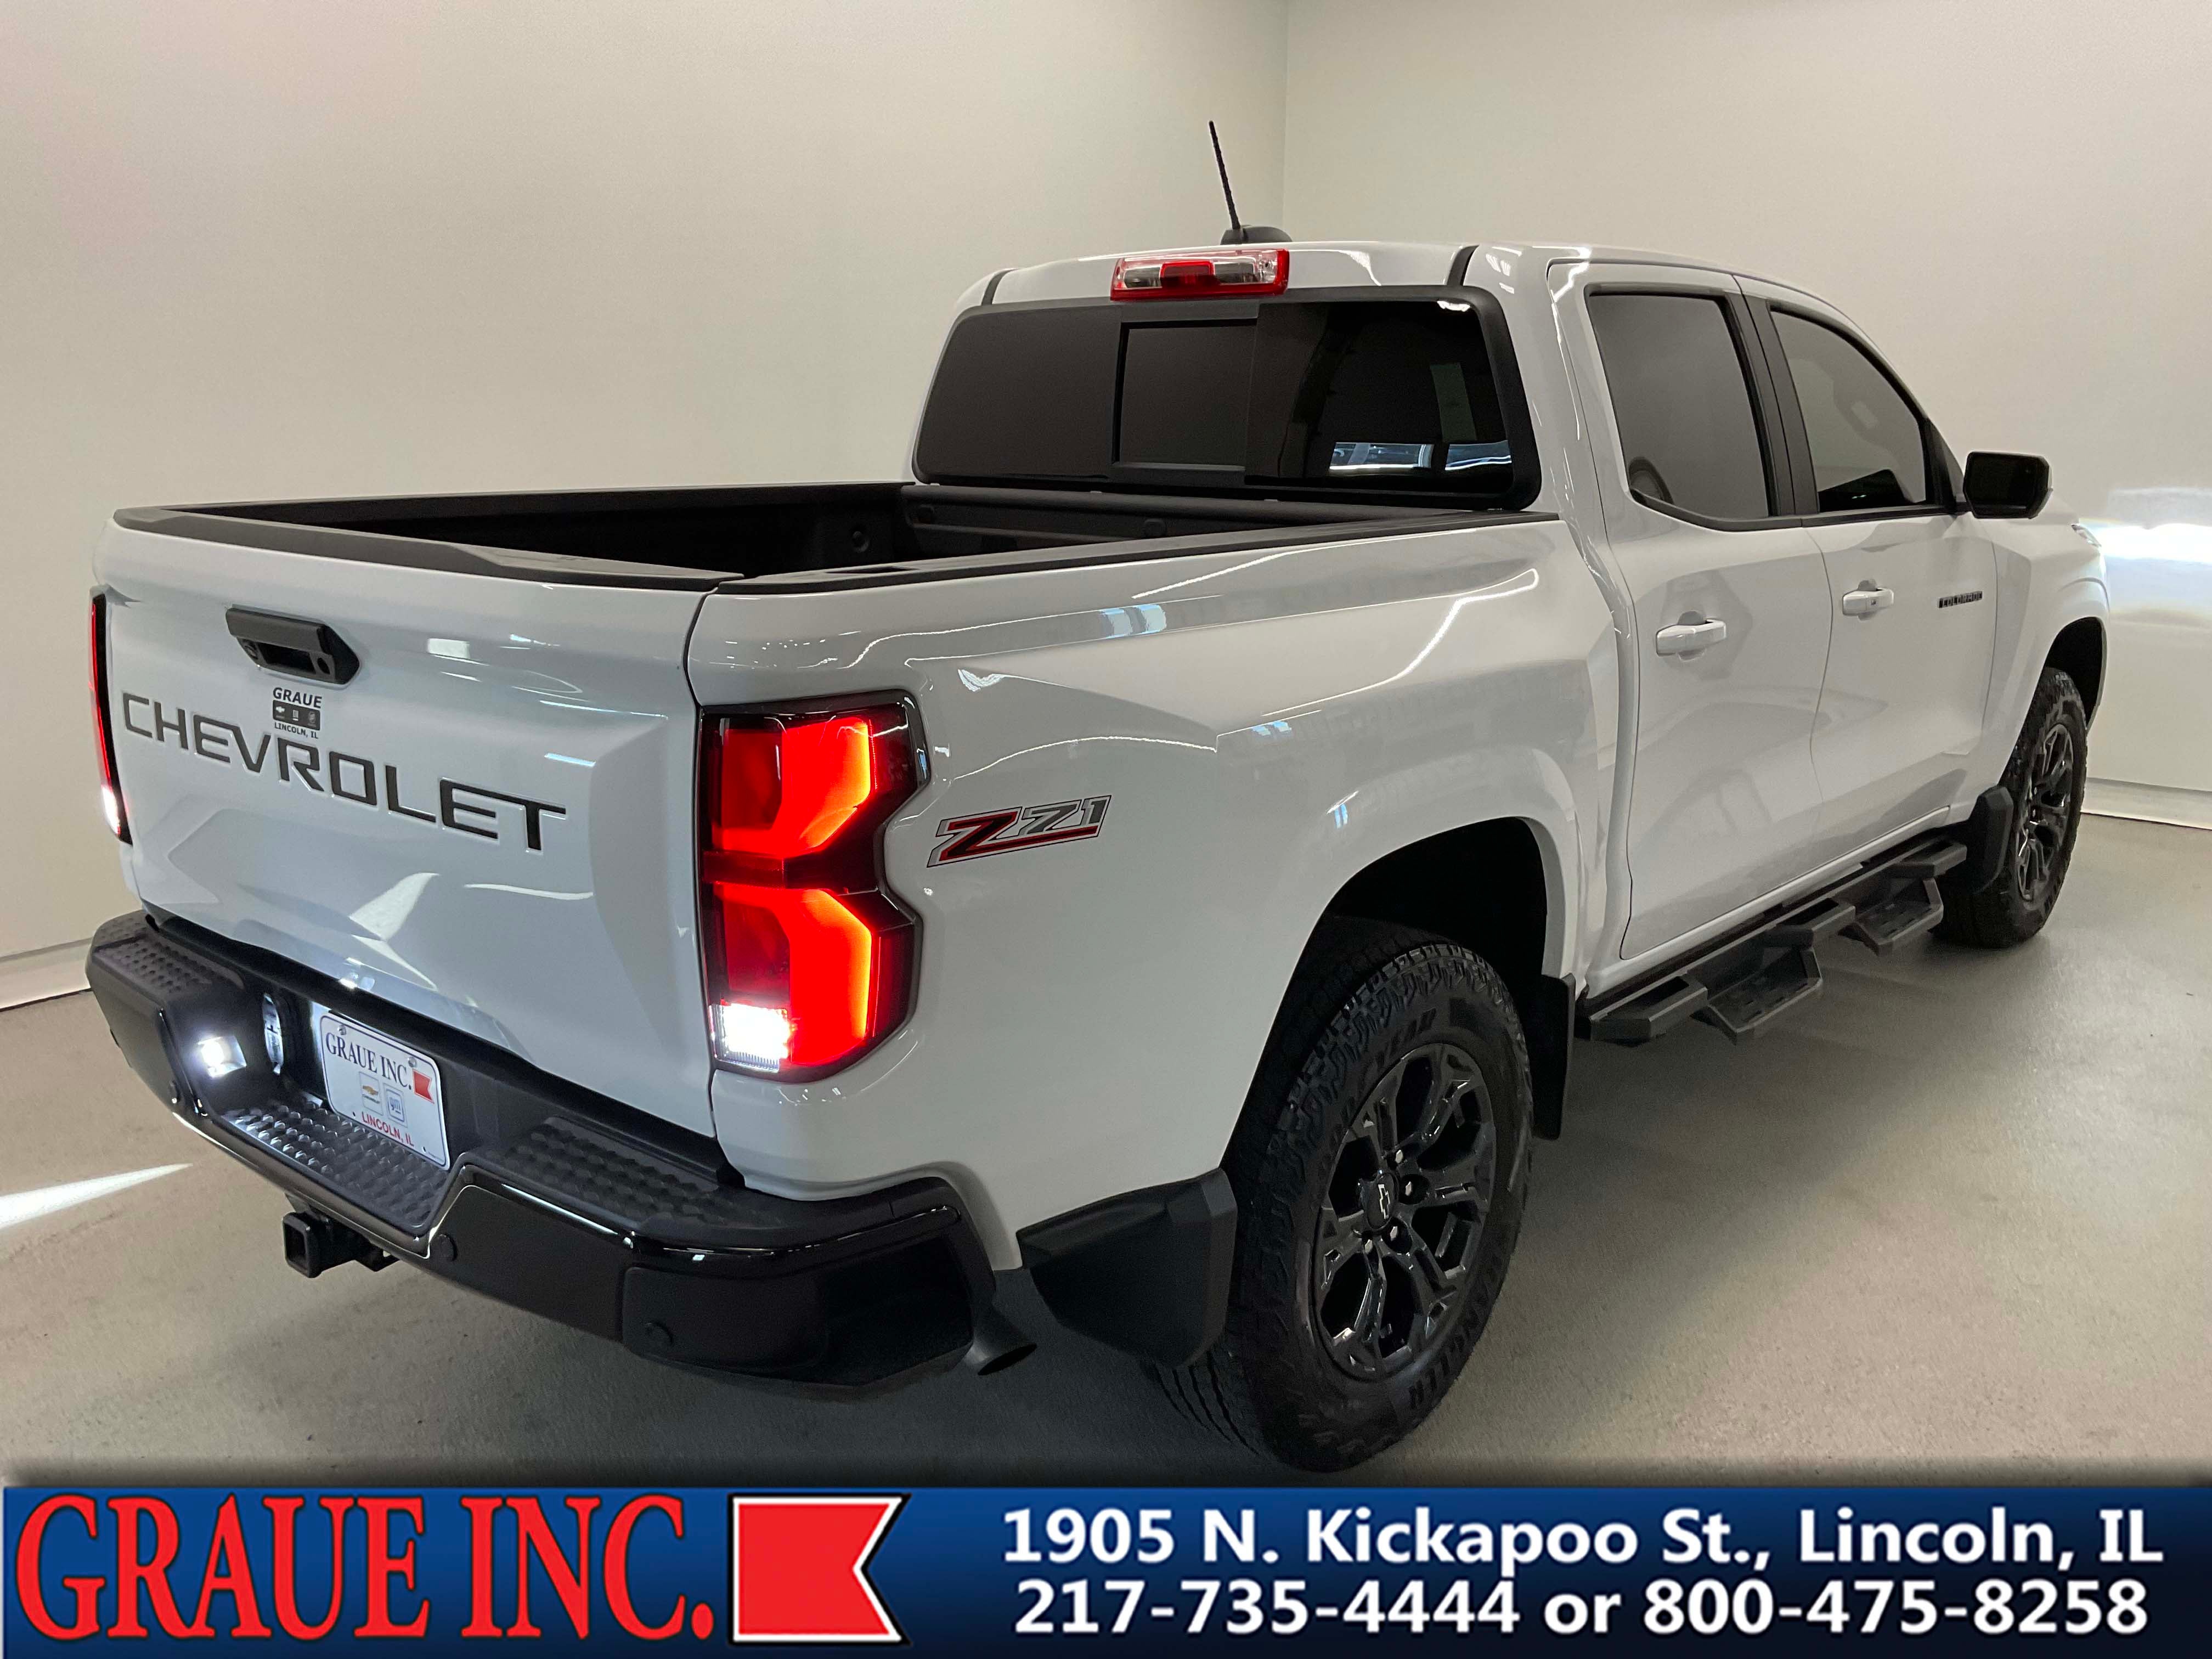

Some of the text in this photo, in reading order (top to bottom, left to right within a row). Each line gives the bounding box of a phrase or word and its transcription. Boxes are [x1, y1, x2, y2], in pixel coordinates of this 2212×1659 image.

[273, 687, 323, 709] GRAUE
[274, 721, 319, 739] LINCOLN, IL
[122, 691, 567, 851] CHEVROLET
[927, 794, 1112, 868] Z71
[325, 1032, 412, 1090] GRAUE INC.
[362, 1111, 414, 1147] LINCOLN, IL
